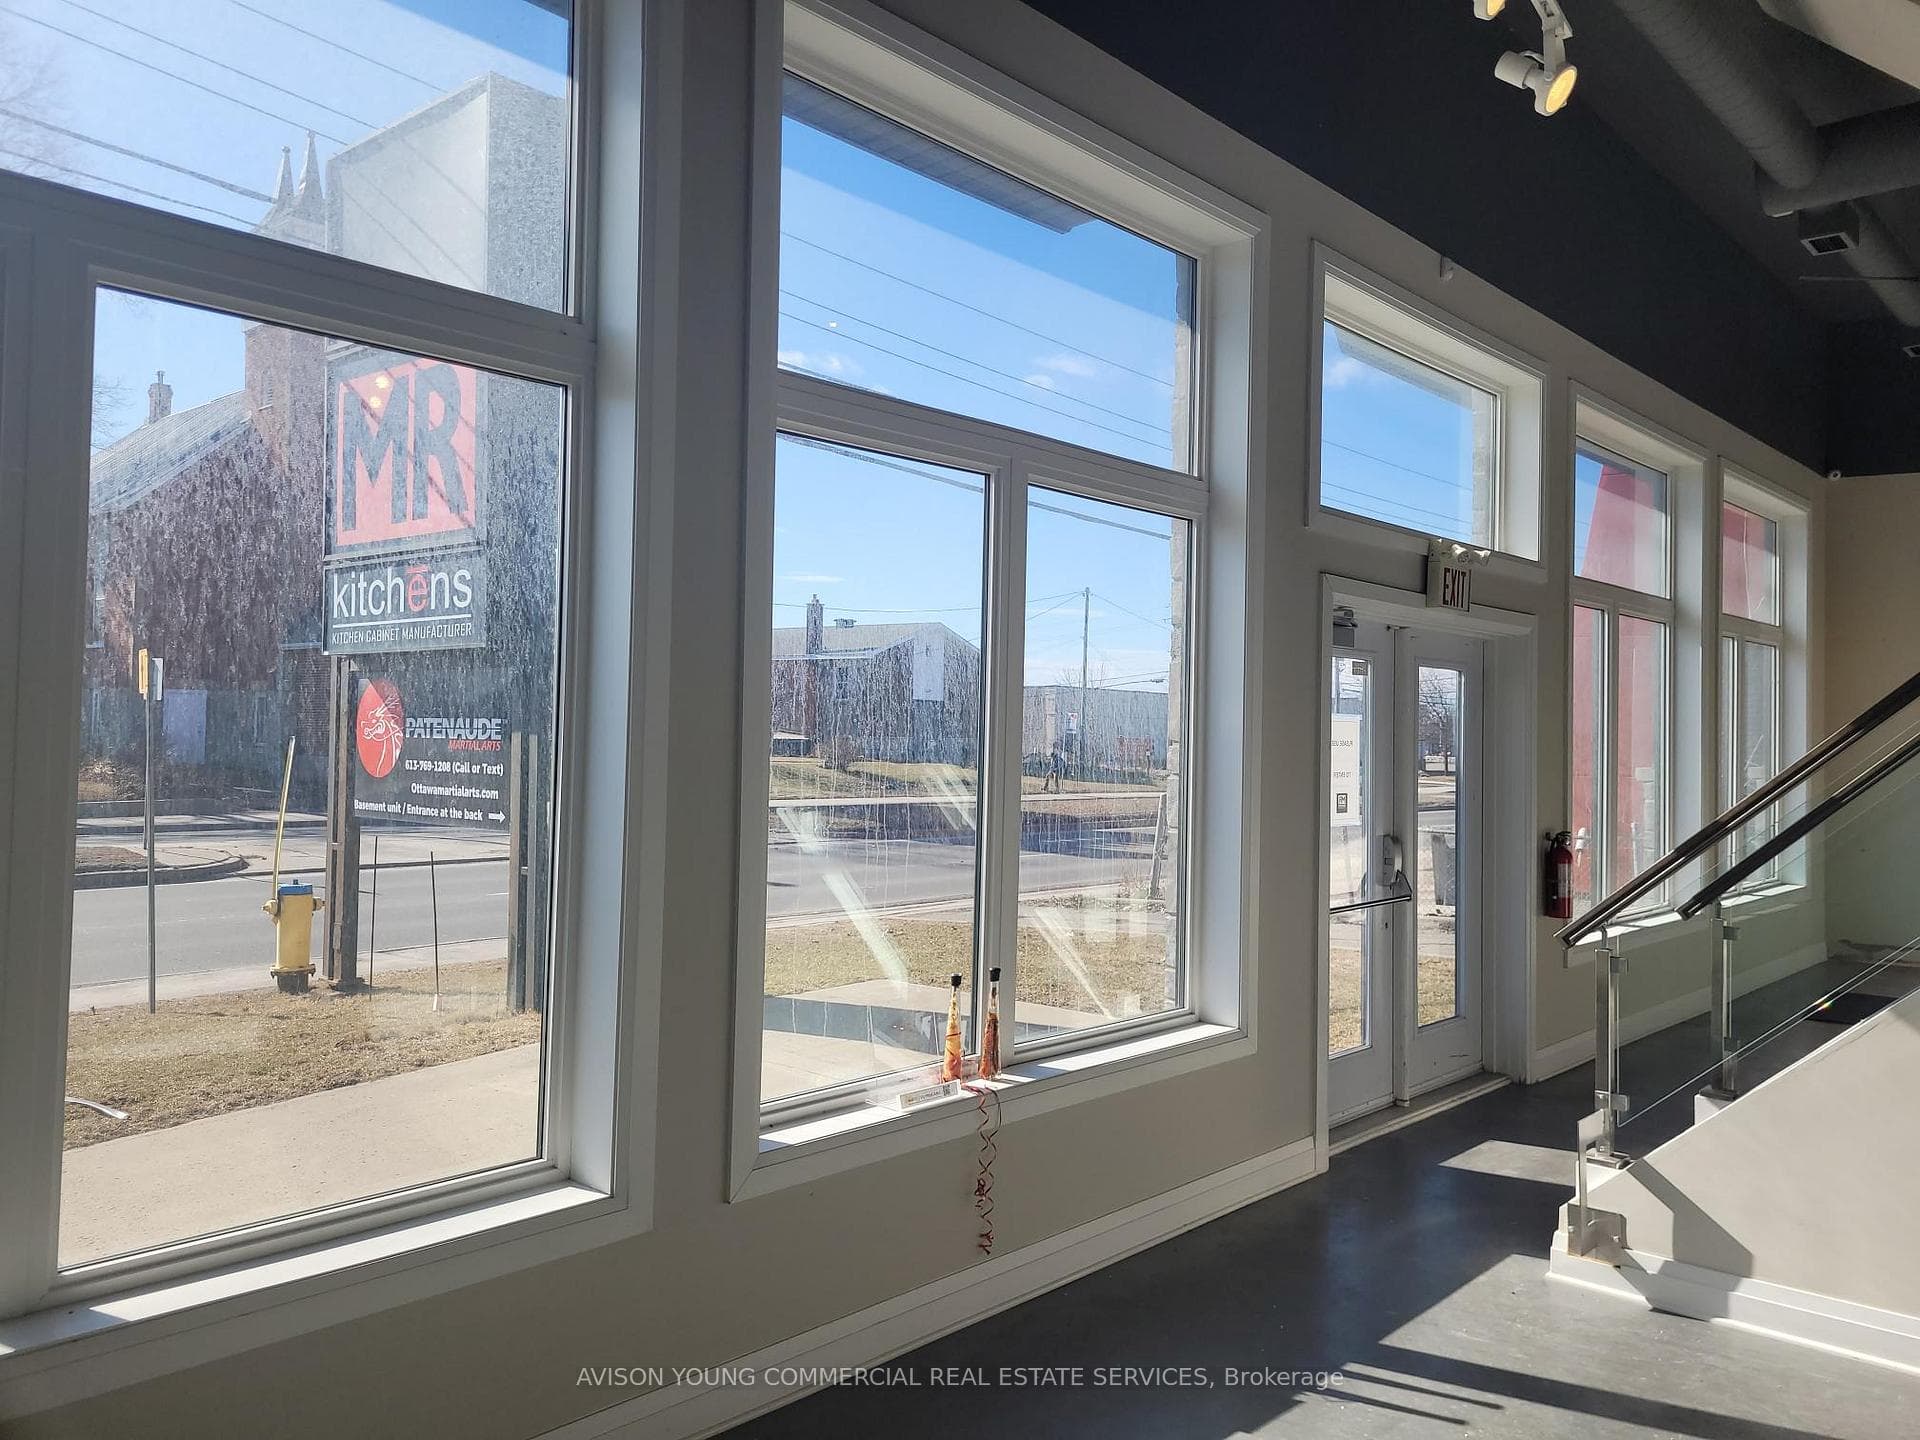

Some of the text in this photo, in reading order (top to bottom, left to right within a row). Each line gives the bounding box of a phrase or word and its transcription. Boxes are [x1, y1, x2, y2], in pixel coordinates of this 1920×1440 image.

[342, 364, 469, 532] MR
[1442, 567, 1467, 609] EXIT
[332, 622, 473, 645] KITCHEN CABINET MANUFACTURER
[405, 717, 502, 740] PATENAUDE
[448, 740, 501, 752] MARTIAL ARTS
[405, 759, 504, 777] 613-769-1208 (Call or Text)
[411, 783, 499, 800] Ottawamartialarts.com
[354, 799, 386, 812] Basement
[387, 801, 401, 812] unit
[407, 803, 439, 818] Entrance
[440, 807, 449, 818] at
[450, 807, 462, 819] the
[464, 808, 483, 821] back
